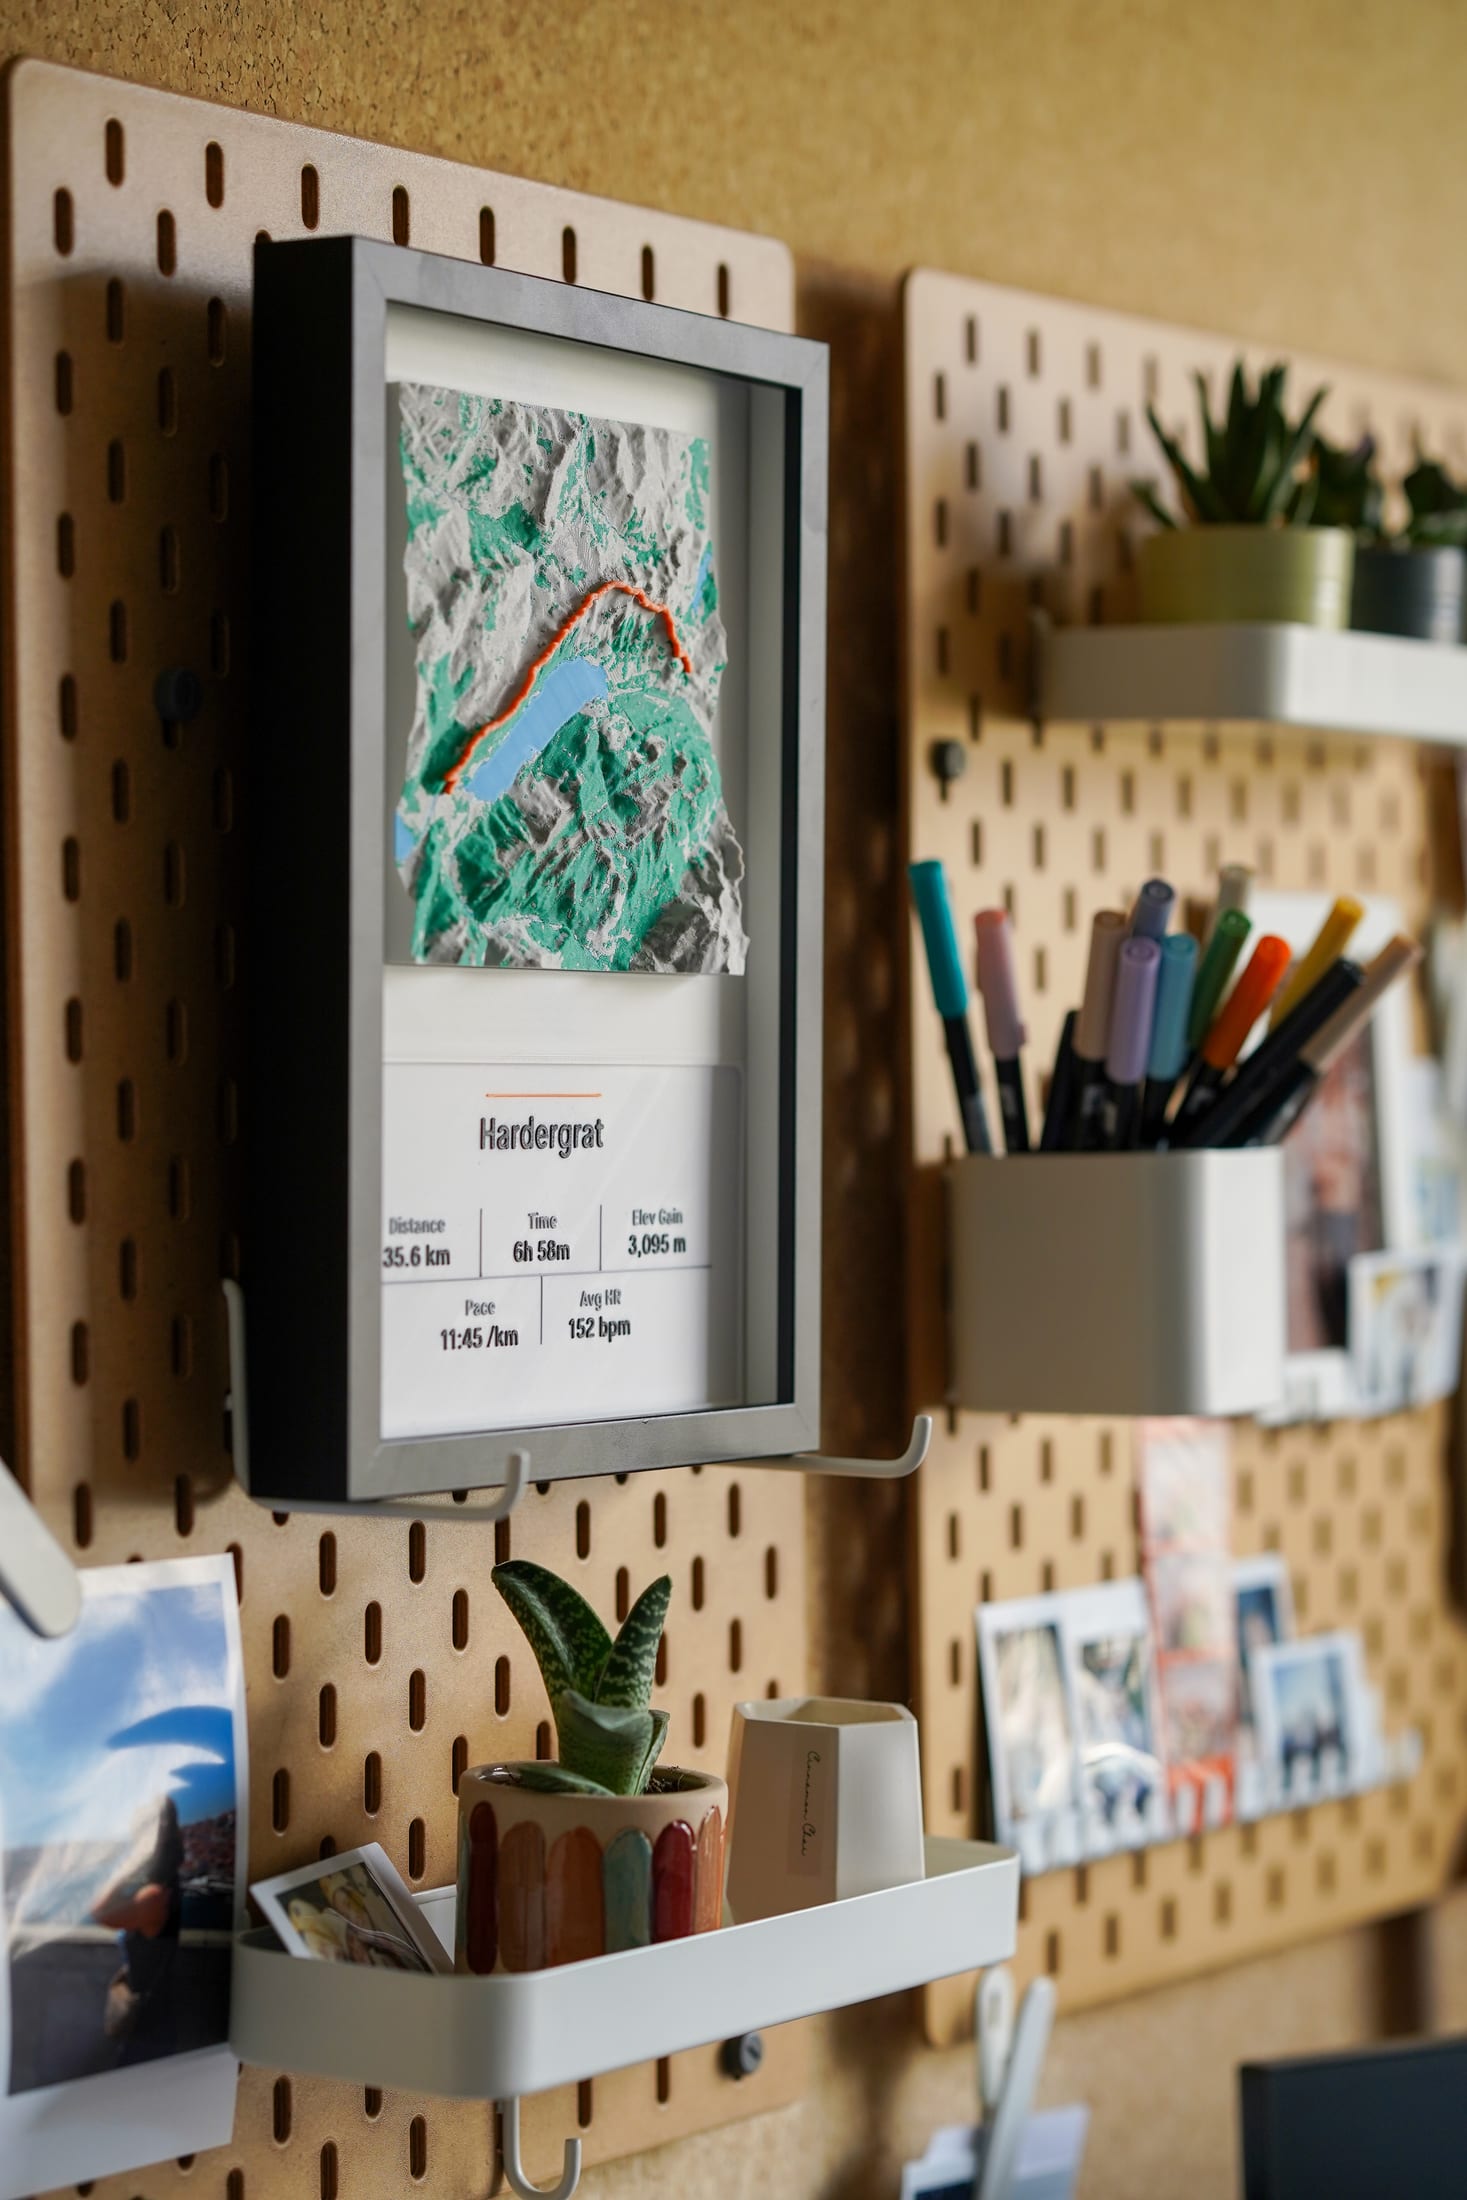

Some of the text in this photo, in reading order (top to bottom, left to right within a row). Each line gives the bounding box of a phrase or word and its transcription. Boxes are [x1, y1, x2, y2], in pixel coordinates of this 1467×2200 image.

[478, 1115, 604, 1159] Hardergrat
[388, 1216, 446, 1235] Distance
[527, 1211, 558, 1230] Time
[631, 1207, 684, 1226] Elev Gain
[381, 1243, 451, 1269] 35.6 km
[512, 1239, 571, 1263] 6h 58m
[627, 1234, 687, 1259] 3,095 m
[464, 1298, 496, 1317] Pace
[579, 1288, 622, 1312] Avg HR
[440, 1324, 519, 1351] 11:45 /km
[568, 1315, 631, 1344] 152 bpm
